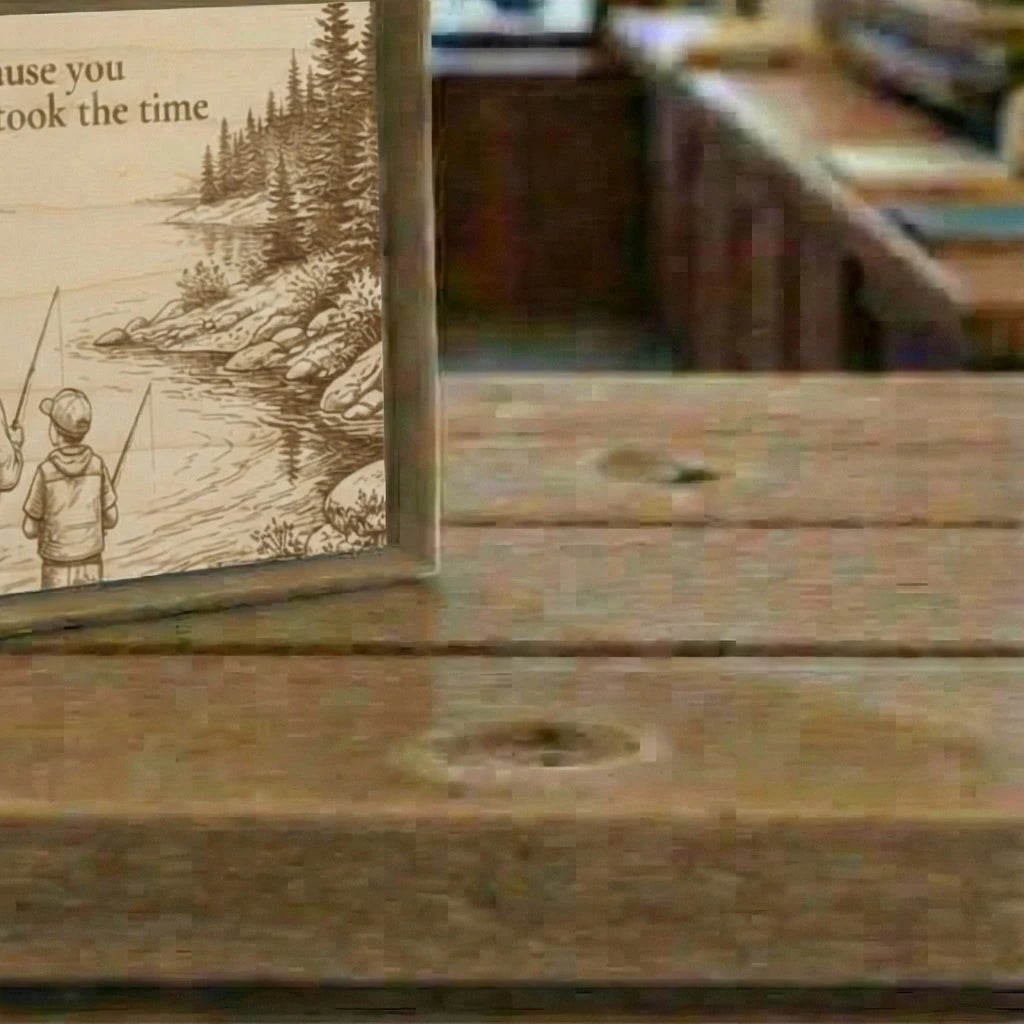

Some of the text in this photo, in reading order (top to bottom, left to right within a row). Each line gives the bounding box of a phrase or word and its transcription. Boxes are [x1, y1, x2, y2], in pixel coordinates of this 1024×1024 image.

[66, 60, 125, 95] you
[79, 91, 128, 126] the
[140, 93, 209, 124] time
